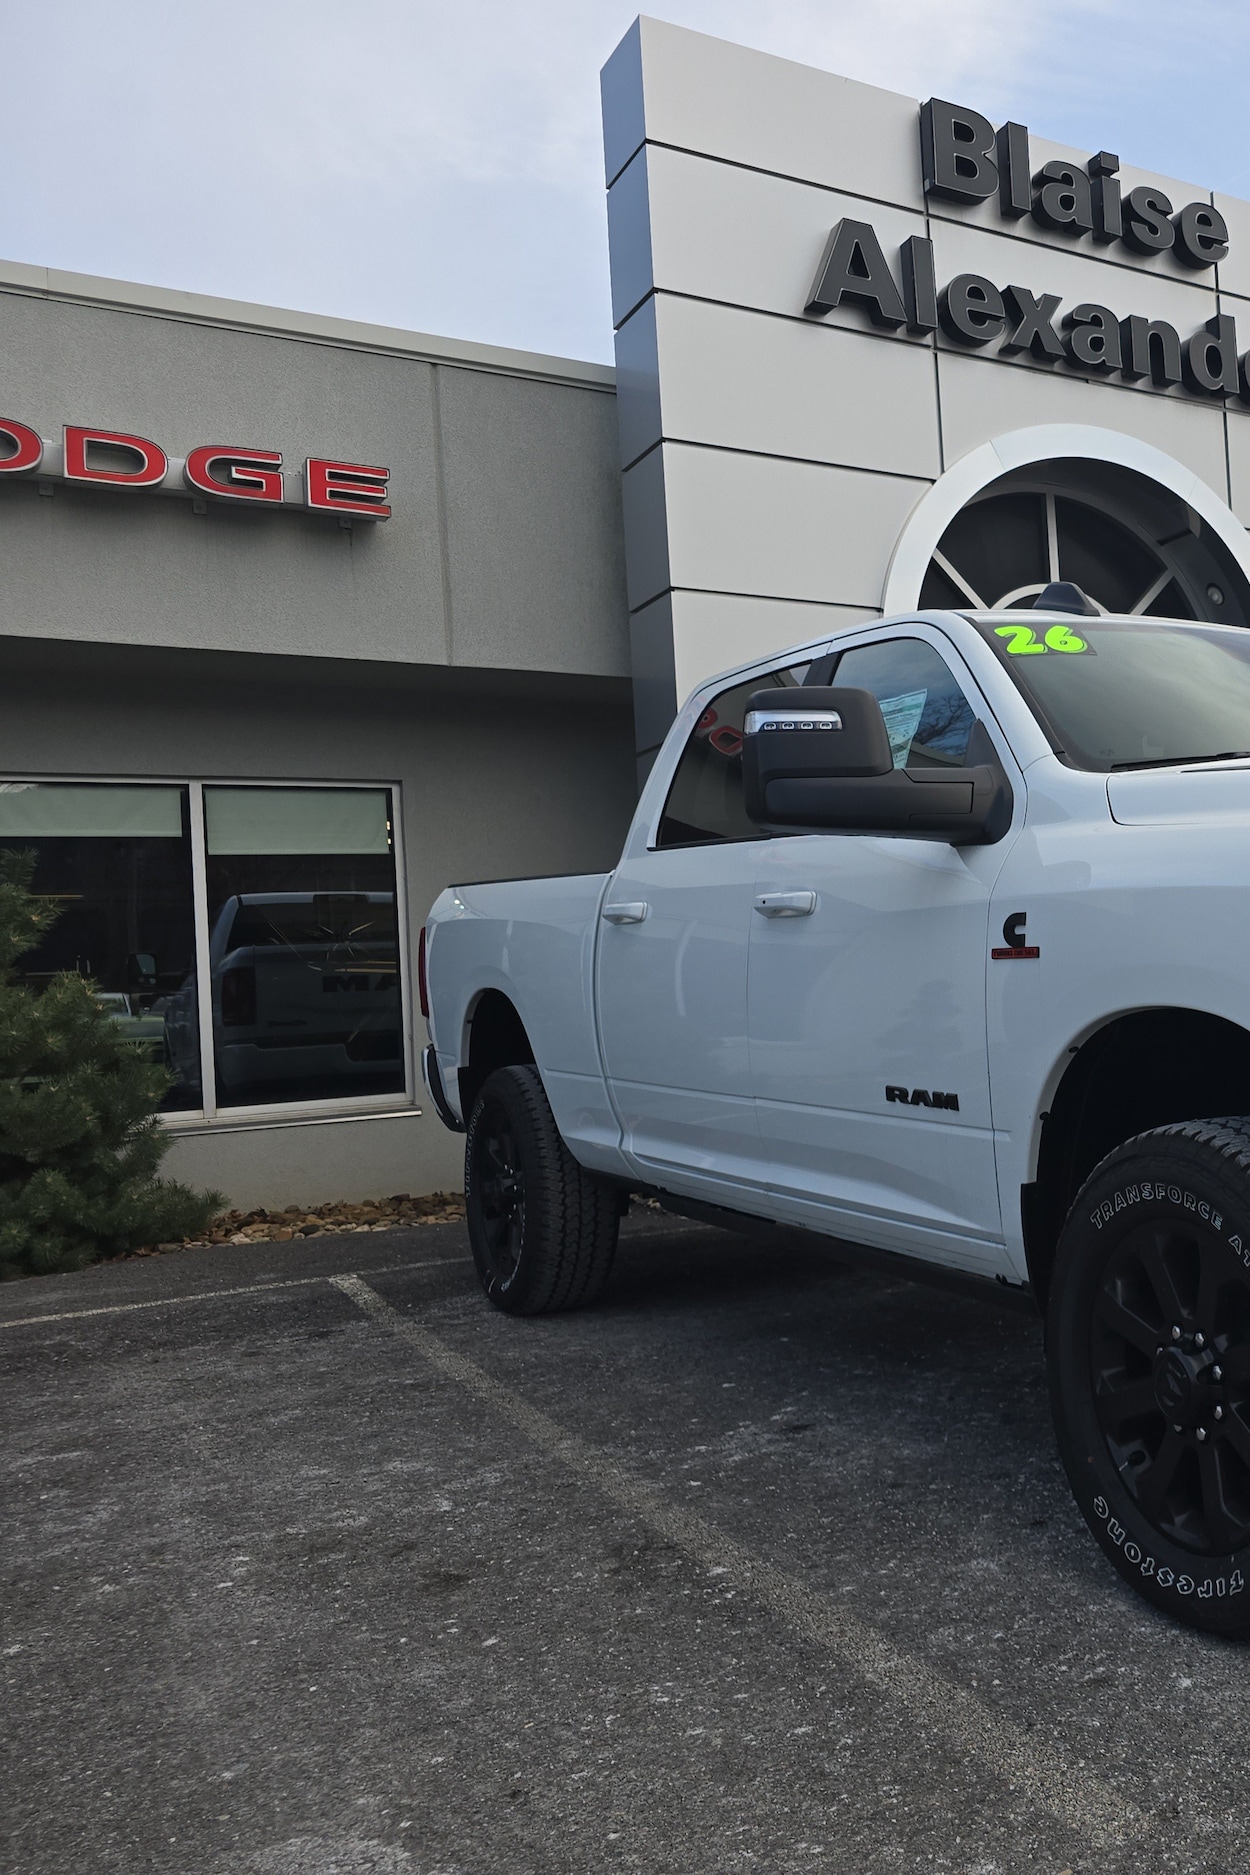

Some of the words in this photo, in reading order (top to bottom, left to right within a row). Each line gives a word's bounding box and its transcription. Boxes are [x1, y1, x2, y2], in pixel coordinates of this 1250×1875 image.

[921, 97, 1230, 270] Blaise
[993, 624, 1089, 656] 26
[886, 1085, 960, 1112] RAM
[1090, 1182, 1223, 1231] TRANSFORCE
